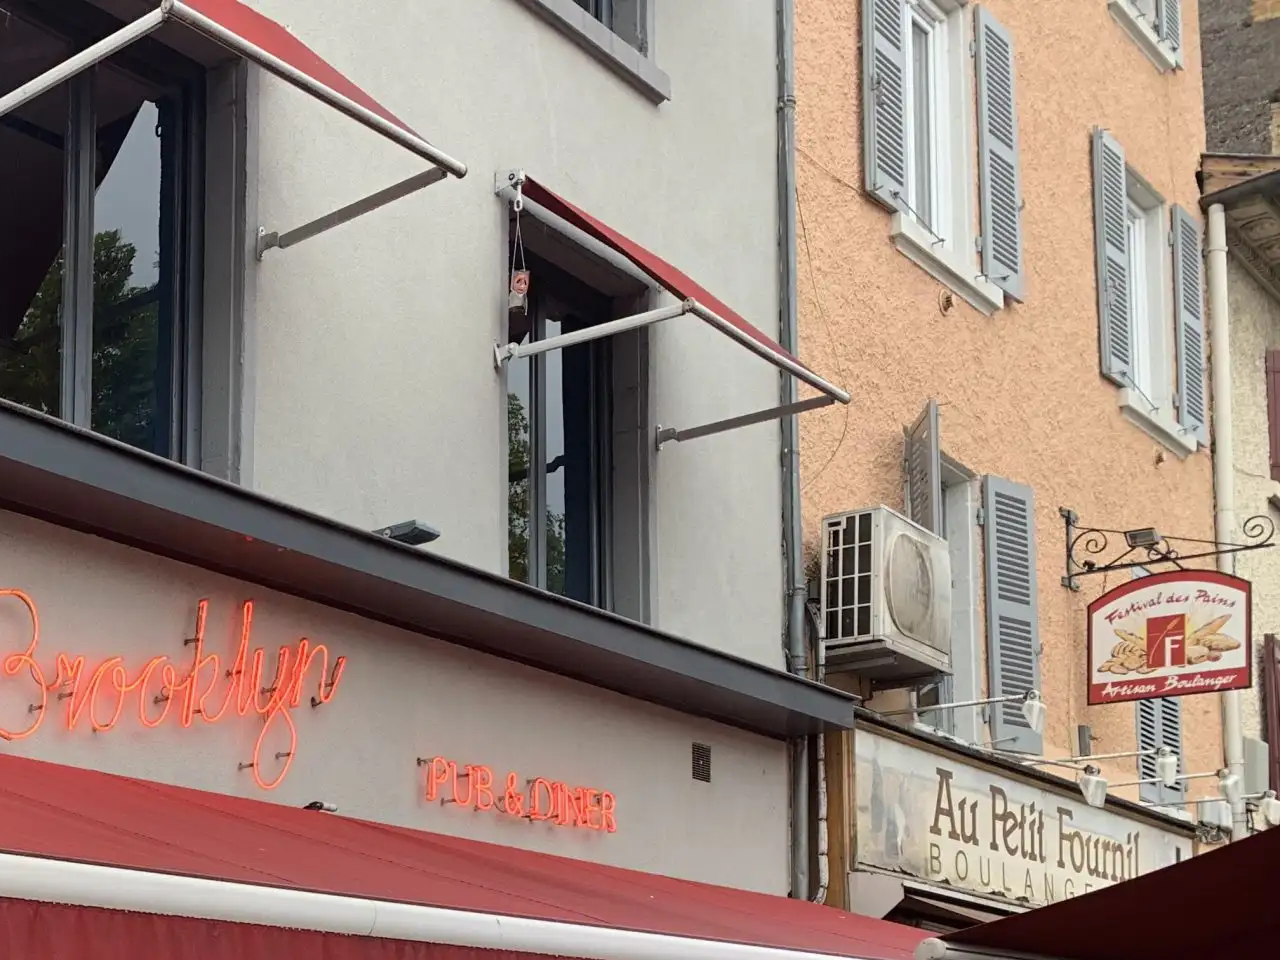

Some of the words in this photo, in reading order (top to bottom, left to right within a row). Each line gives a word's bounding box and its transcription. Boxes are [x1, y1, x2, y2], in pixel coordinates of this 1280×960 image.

[1104, 592, 1162, 625] Festival
[1165, 592, 1190, 604] des
[1195, 588, 1236, 608] Pains
[1101, 682, 1157, 698] Artisan
[1158, 674, 1237, 693] Boulanger
[425, 756, 494, 810] PUB
[504, 772, 524, 816] &
[529, 776, 617, 833] DINER
[929, 767, 979, 846] Au
[989, 784, 1046, 864] Petit
[1056, 806, 1140, 883] Fournil
